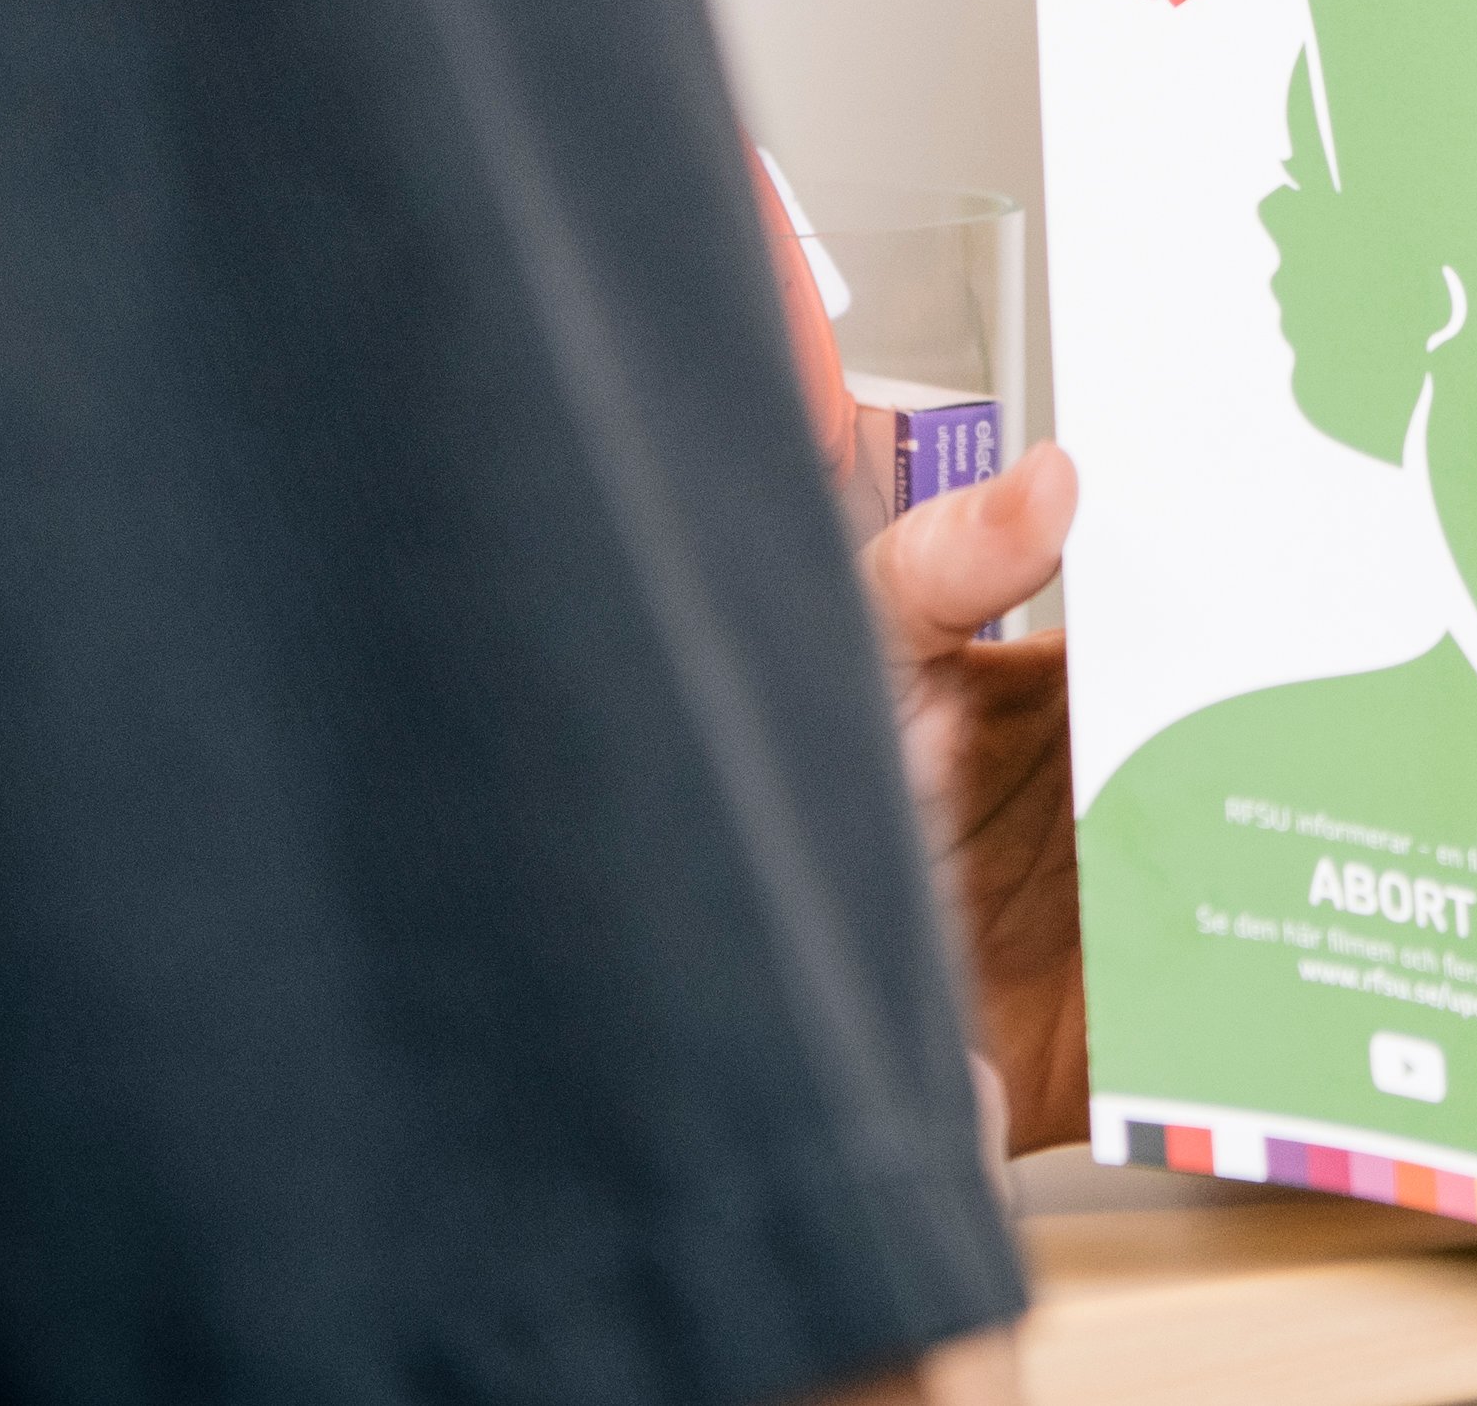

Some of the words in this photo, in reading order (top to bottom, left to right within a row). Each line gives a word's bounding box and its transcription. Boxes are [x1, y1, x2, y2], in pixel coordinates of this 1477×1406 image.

[1224, 795, 1292, 833] RFSU
[1295, 811, 1413, 856] informerar
[1436, 843, 1465, 870] en
[1308, 856, 1477, 939] ABORT
[1195, 902, 1229, 936] Se
[1233, 910, 1280, 943] den
[1282, 917, 1323, 950] här
[1326, 925, 1397, 966] filmen
[1399, 945, 1440, 975] och
